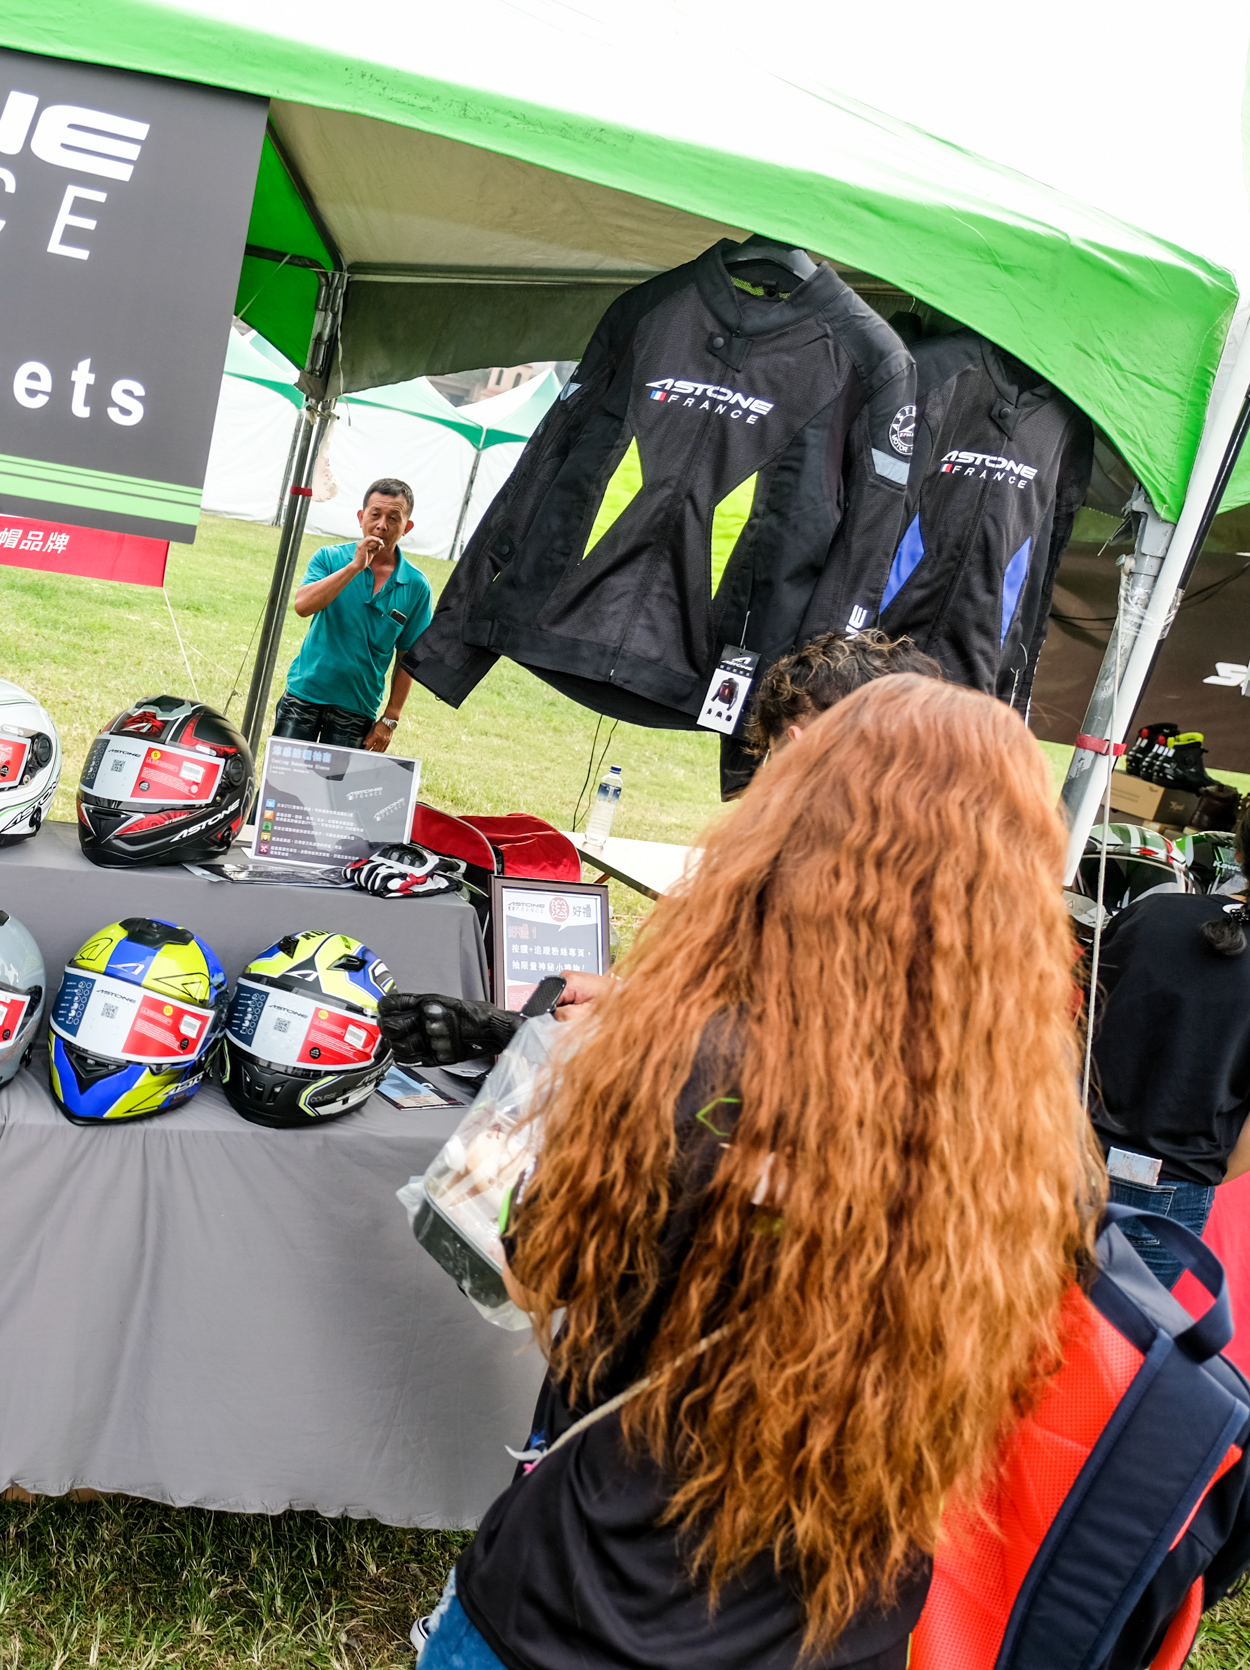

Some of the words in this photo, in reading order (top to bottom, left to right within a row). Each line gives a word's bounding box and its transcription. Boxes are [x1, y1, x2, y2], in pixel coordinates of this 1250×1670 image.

[645, 378, 775, 415] ASTONE
[667, 394, 759, 425] FRANCE
[941, 450, 1038, 480] ASTONE
[951, 465, 1028, 489] FRANCE
[108, 748, 142, 758] ASTONE
[170, 799, 240, 843] ASTONE
[551, 900, 567, 919] 送
[96, 989, 138, 1004] ASTONE
[269, 1004, 308, 1019] ASTONE
